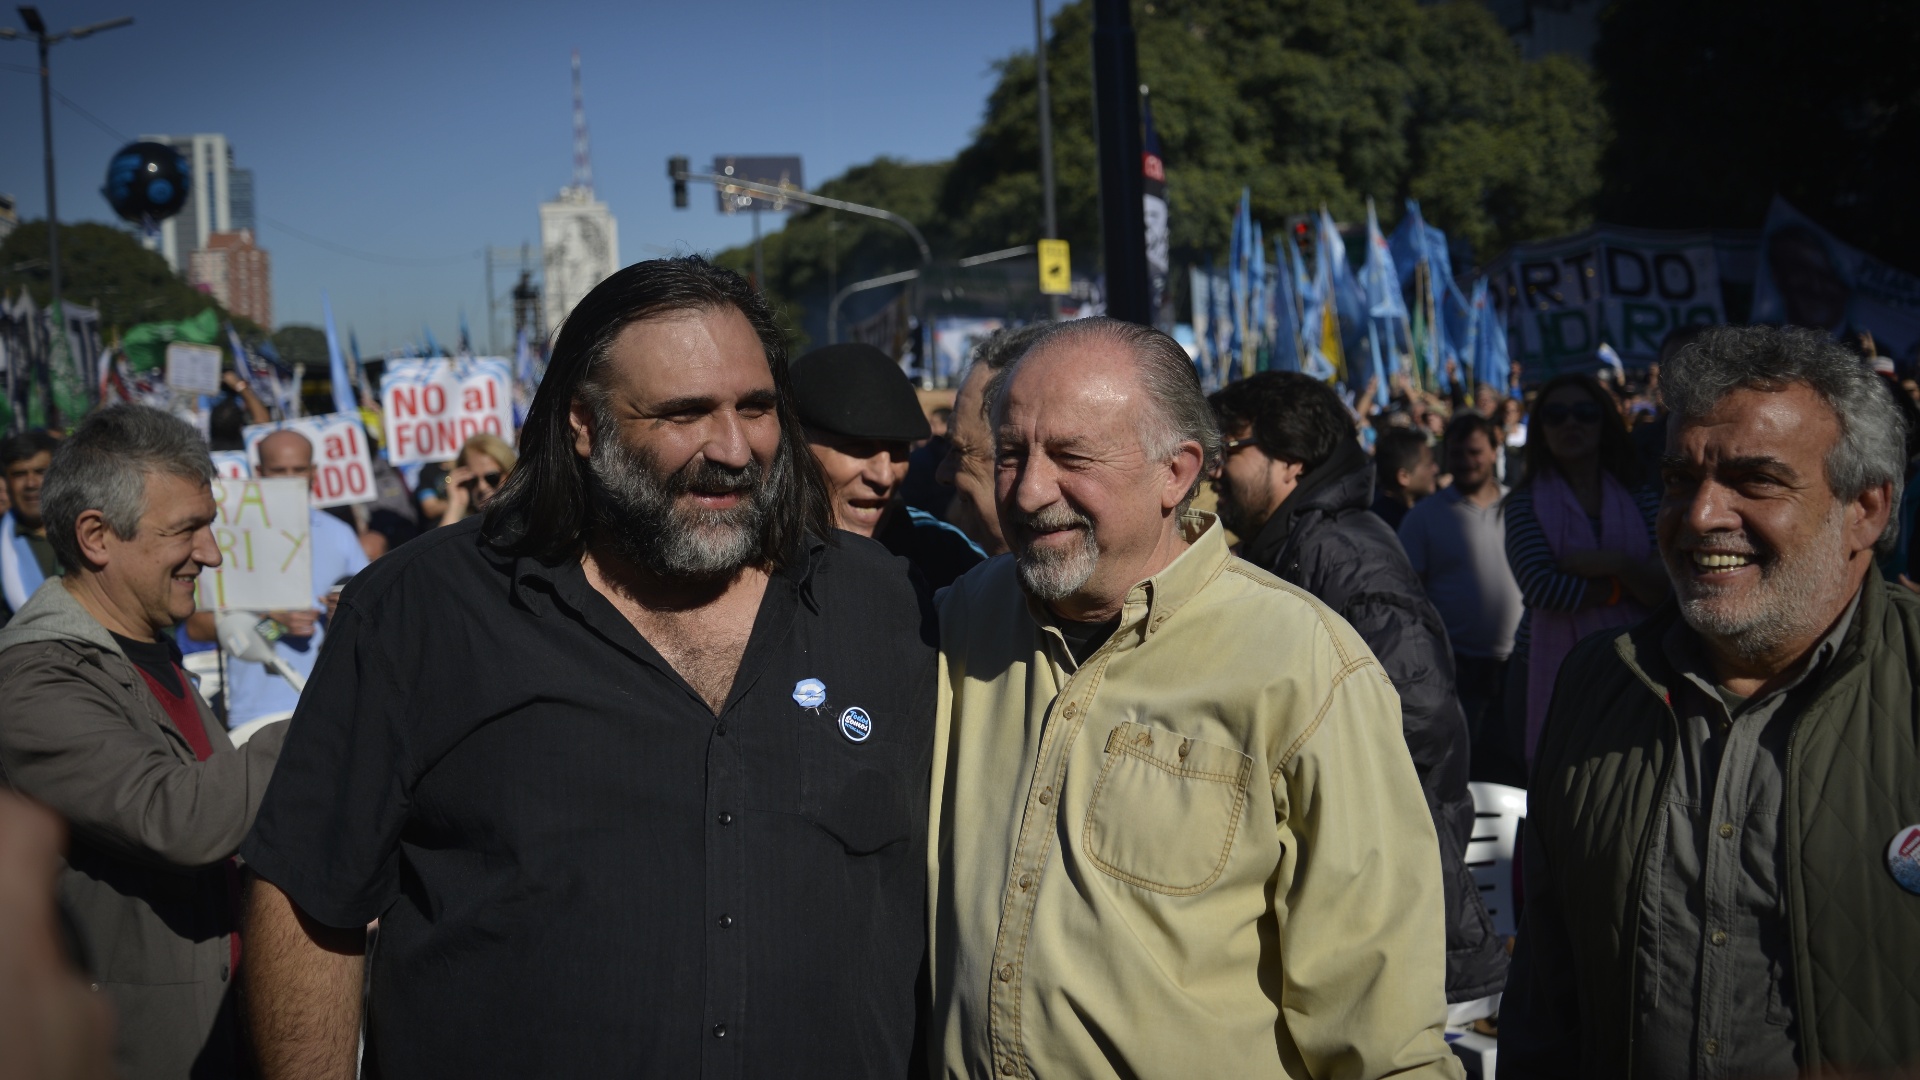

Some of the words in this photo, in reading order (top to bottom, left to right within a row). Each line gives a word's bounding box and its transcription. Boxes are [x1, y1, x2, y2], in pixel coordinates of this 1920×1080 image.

[392, 384, 447, 418] NO
[463, 379, 498, 412] al
[325, 427, 358, 461] al
[845, 716, 868, 732] Somos
[850, 711, 868, 725] Todos
